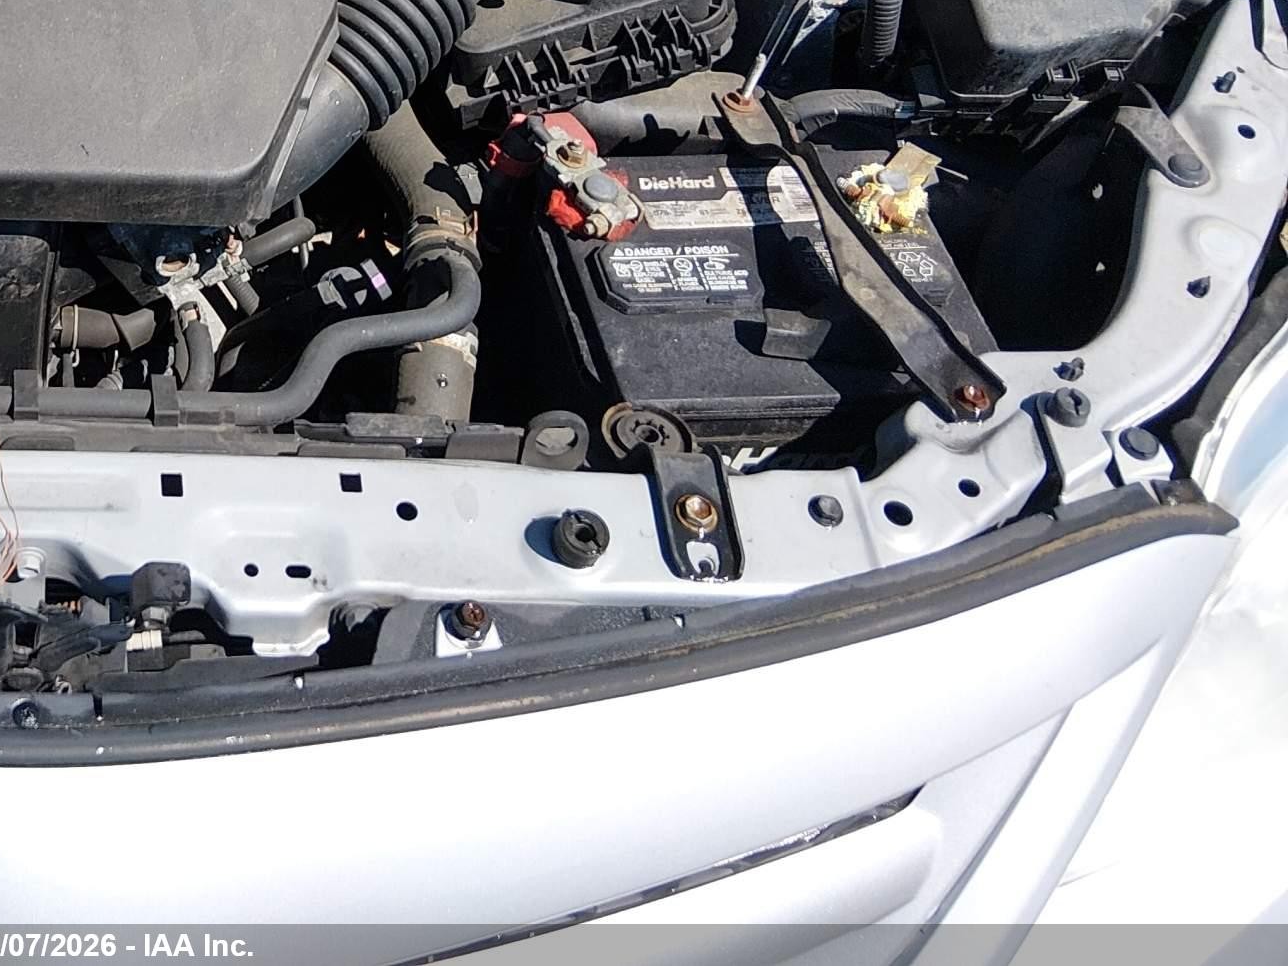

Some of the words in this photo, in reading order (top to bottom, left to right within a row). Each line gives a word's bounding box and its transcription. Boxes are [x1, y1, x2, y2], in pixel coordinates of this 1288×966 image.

[638, 175, 716, 191] DieHard
[624, 247, 674, 256] DANGER
[684, 245, 730, 255] POISON
